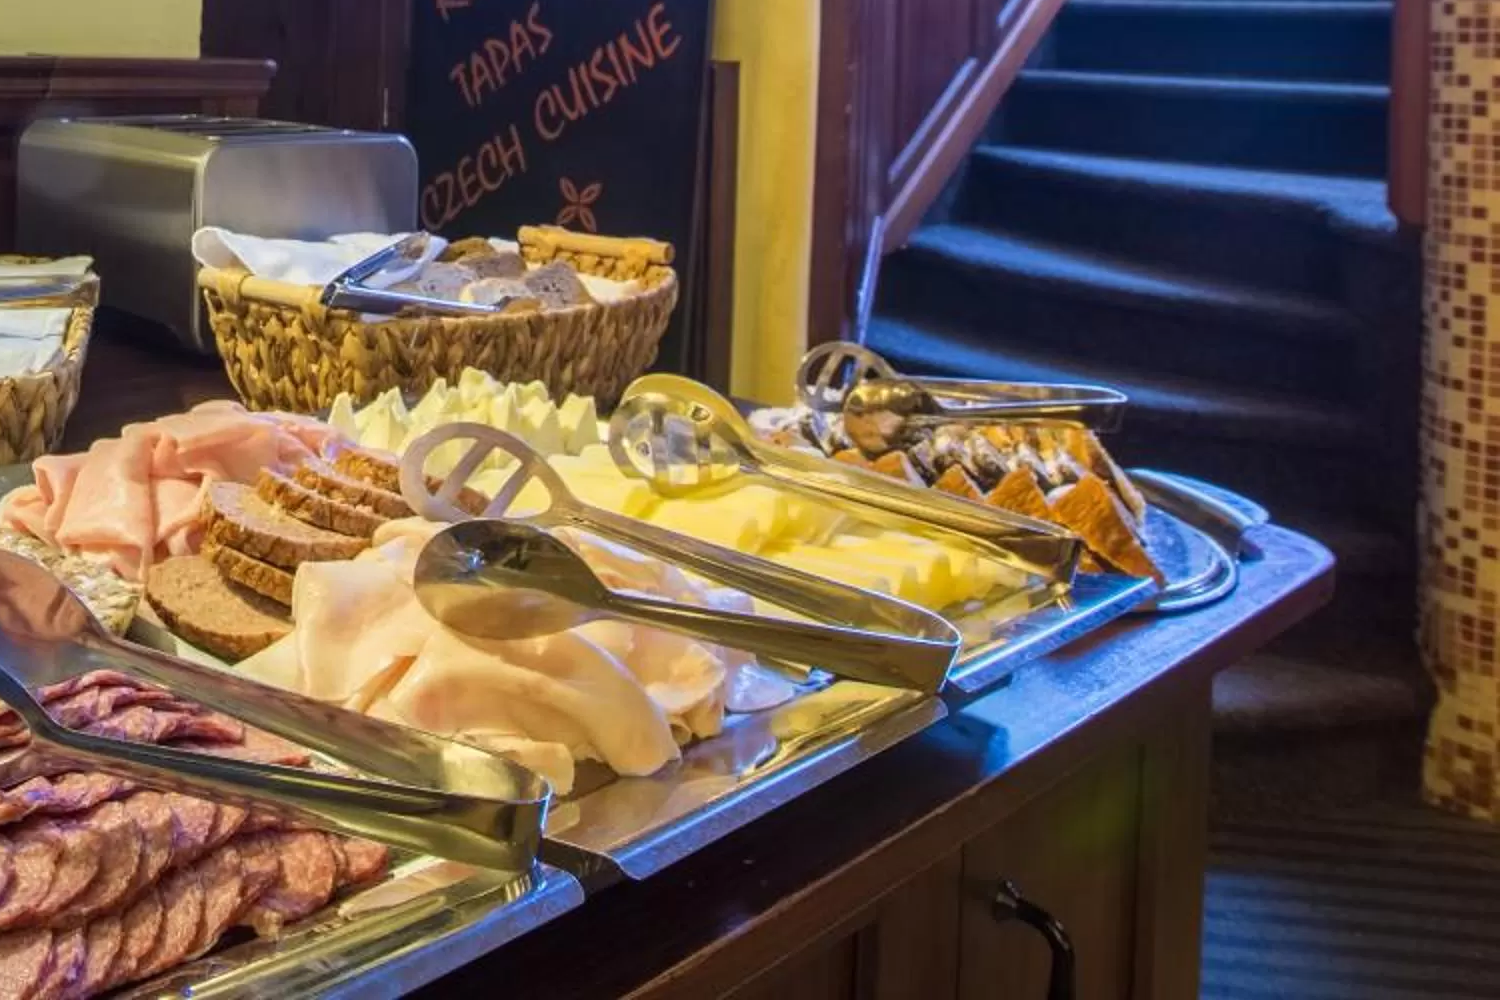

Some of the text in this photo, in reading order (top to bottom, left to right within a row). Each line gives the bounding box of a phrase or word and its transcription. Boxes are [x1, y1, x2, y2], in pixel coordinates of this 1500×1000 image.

[420, 3, 682, 232] CZECH CUISINE
[450, 2, 554, 108] TAPAS
